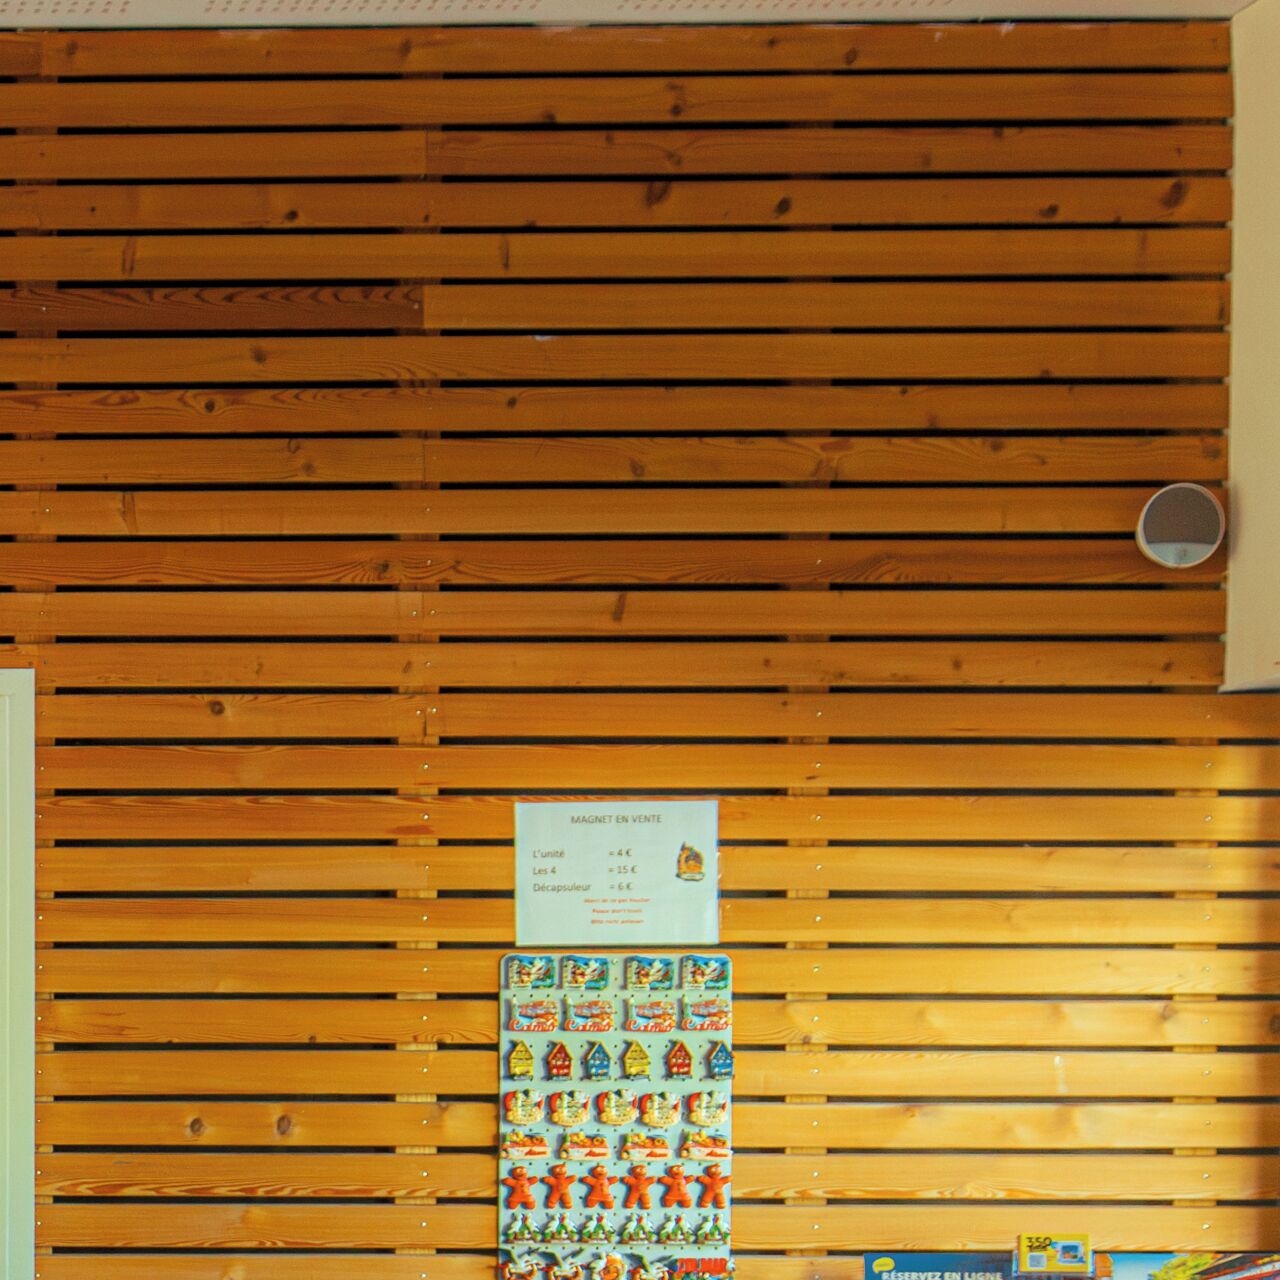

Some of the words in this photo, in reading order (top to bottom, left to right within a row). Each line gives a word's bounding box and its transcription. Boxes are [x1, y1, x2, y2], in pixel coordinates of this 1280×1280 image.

[570, 815, 613, 824] MAGNET
[616, 814, 629, 824] EN
[632, 814, 662, 824] VENTE
[532, 848, 565, 858] L'unité
[616, 848, 623, 857] 4
[625, 848, 633, 857] €
[532, 866, 548, 875] Les
[550, 866, 557, 875] 4
[617, 865, 629, 874] 15
[630, 865, 638, 874] €
[532, 882, 592, 893] Décapsuleur
[618, 883, 624, 891] 6
[626, 883, 633, 891] €
[882, 1270, 942, 1280] RÉSERVEZ
[944, 1271, 961, 1280] EN
[964, 1271, 1003, 1280] LIGNE
